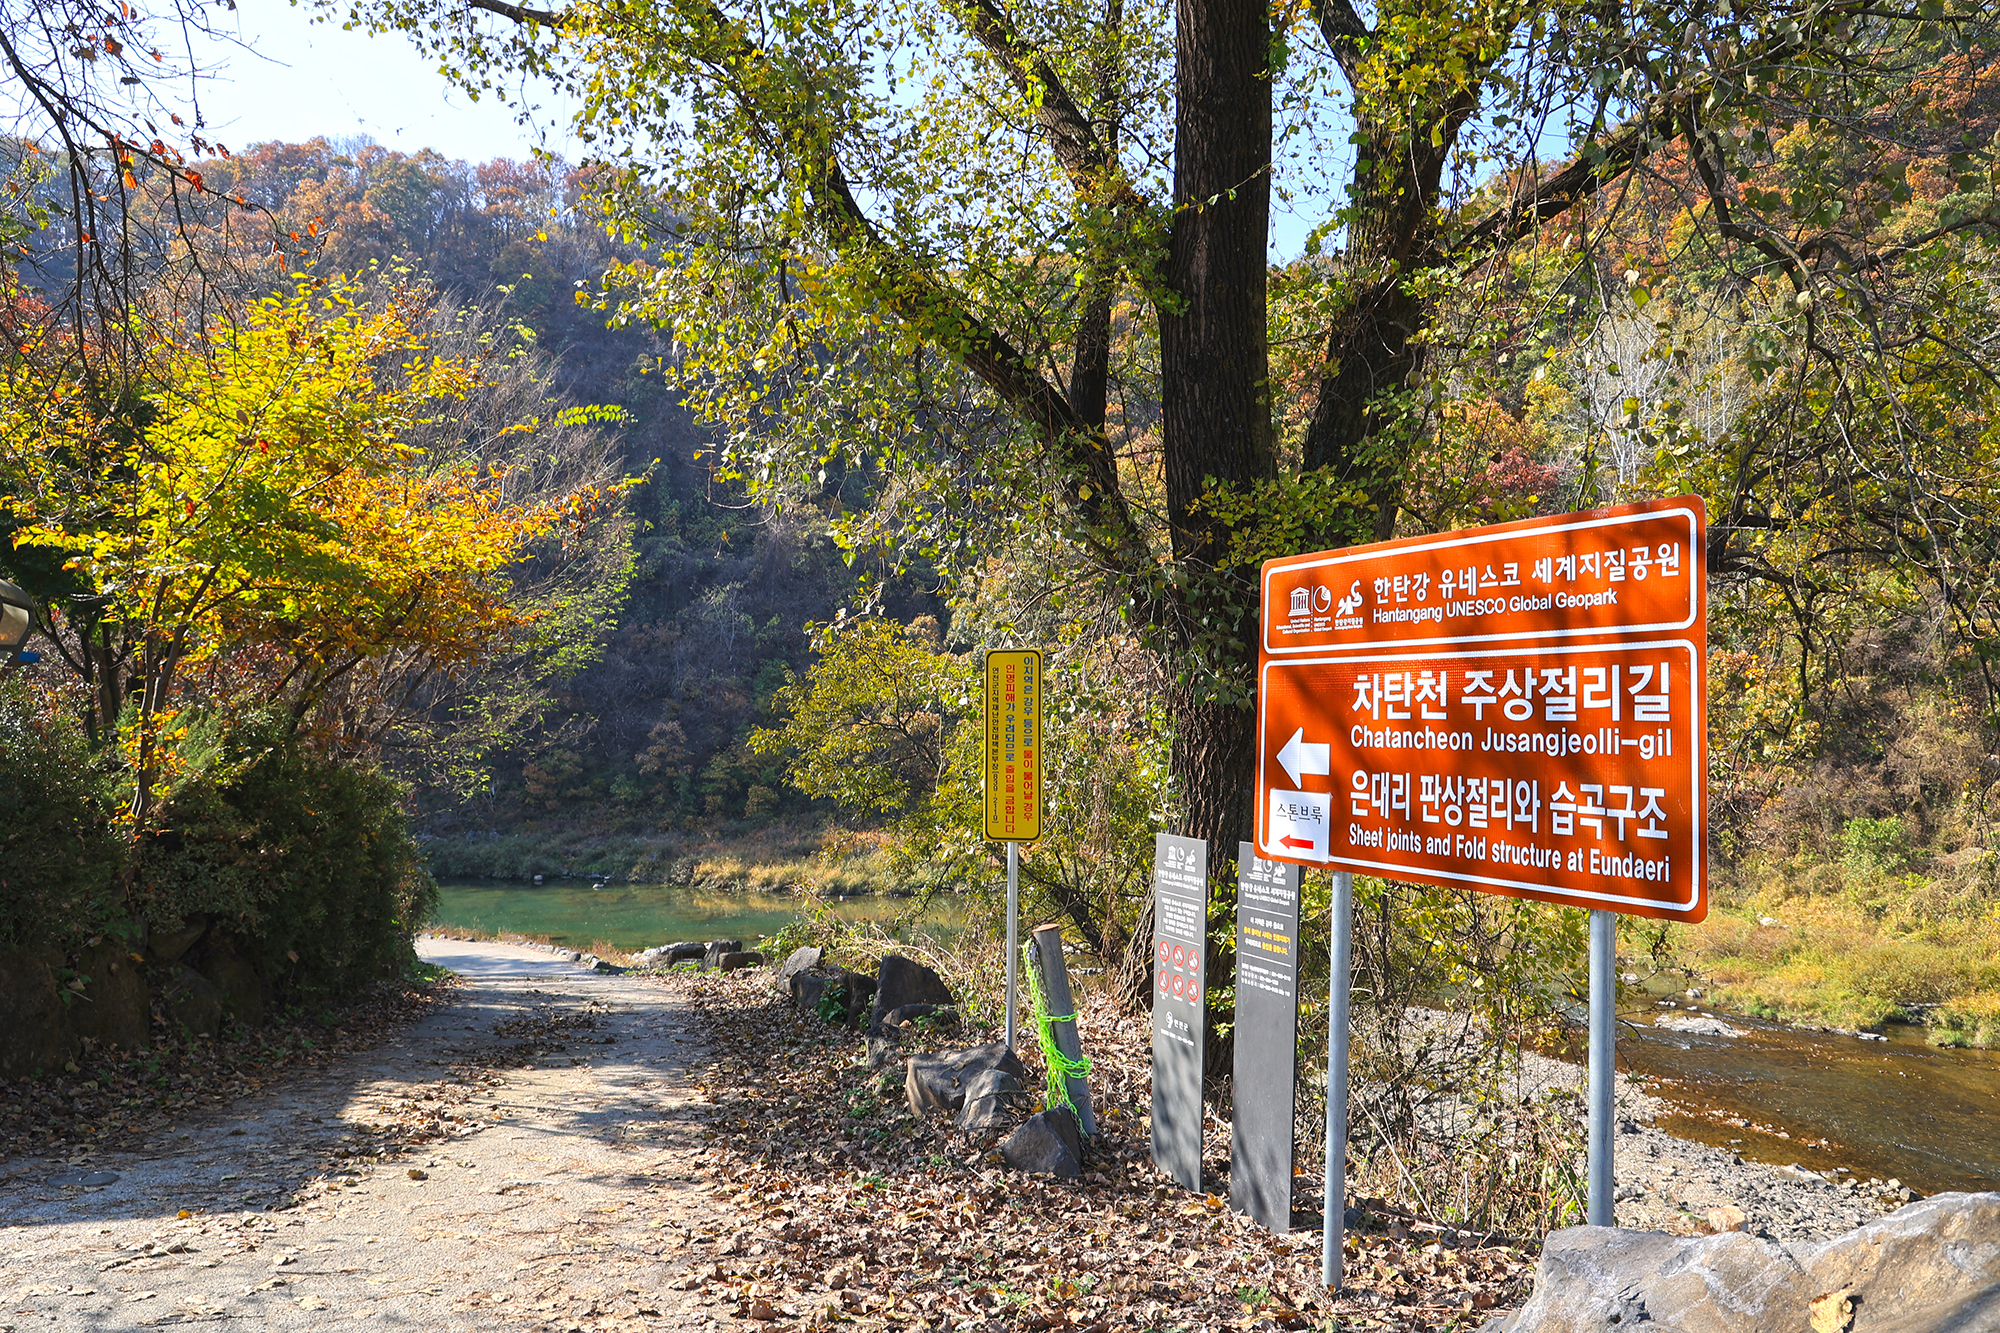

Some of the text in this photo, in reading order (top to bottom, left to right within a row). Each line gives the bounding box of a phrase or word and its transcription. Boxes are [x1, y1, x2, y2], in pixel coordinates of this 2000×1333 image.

[1373, 542, 1680, 604] 한탄강 유네스코 세계지질공원
[1373, 605, 1443, 624] Hantangang
[1446, 597, 1507, 617] UNESCO
[1509, 593, 1552, 612] Global
[1555, 588, 1618, 610] Geopark
[1005, 664, 1016, 712] 인명피해가
[1351, 662, 1671, 722] 차탄천 주상절리길
[1350, 724, 1672, 760] Chatancheon Jusangjeolli-gil
[1276, 803, 1323, 825] 스톤브룩
[1350, 769, 1669, 841] 은대리 판상절리와 습곡구조
[1349, 823, 1670, 882] Sheet joints and Fold structure at Eundaeri
